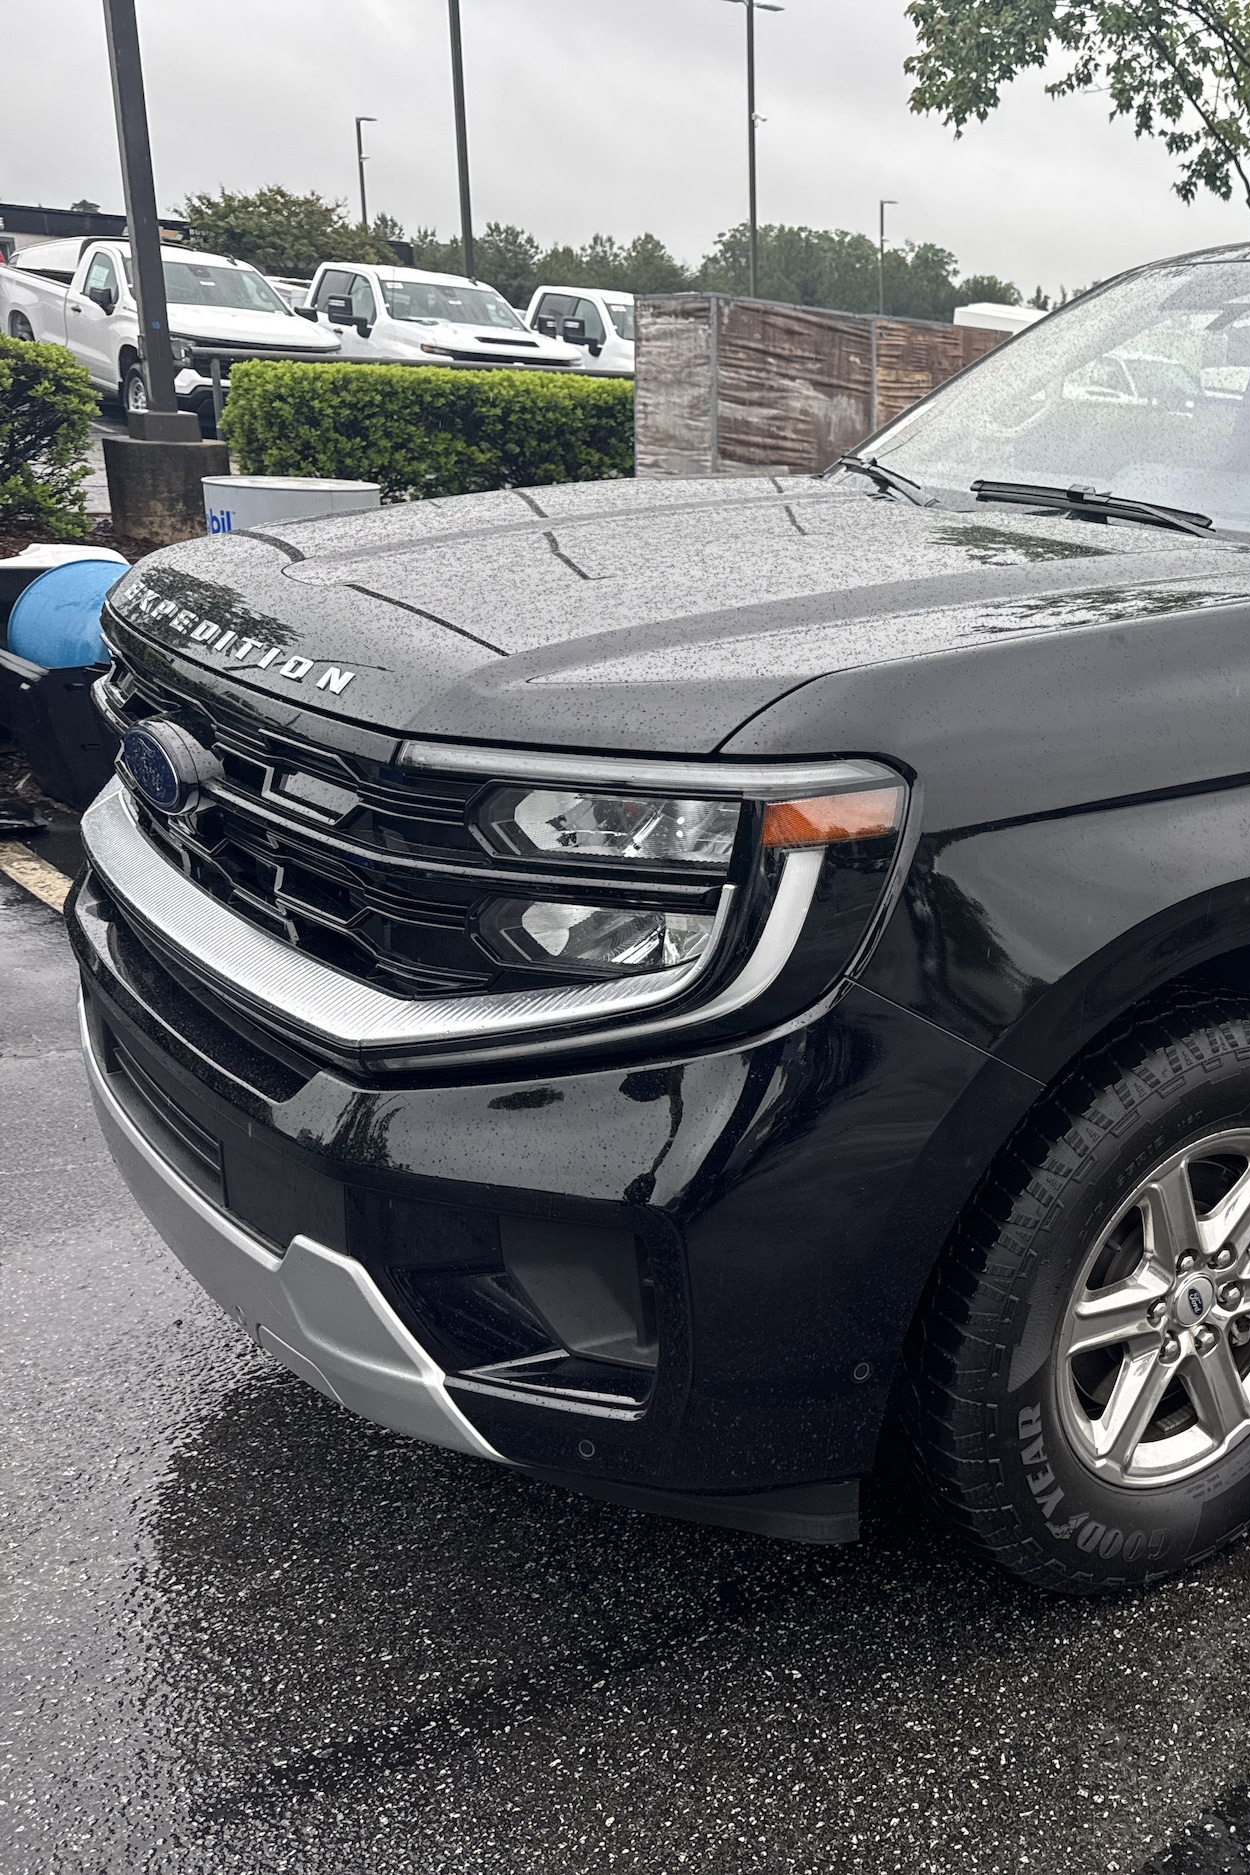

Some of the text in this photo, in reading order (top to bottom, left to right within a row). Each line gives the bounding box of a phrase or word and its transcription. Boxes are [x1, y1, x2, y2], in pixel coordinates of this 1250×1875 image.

[206, 508, 232, 534] bil
[123, 581, 356, 695] EXPEDITION
[1188, 1291, 1202, 1314] Ford
